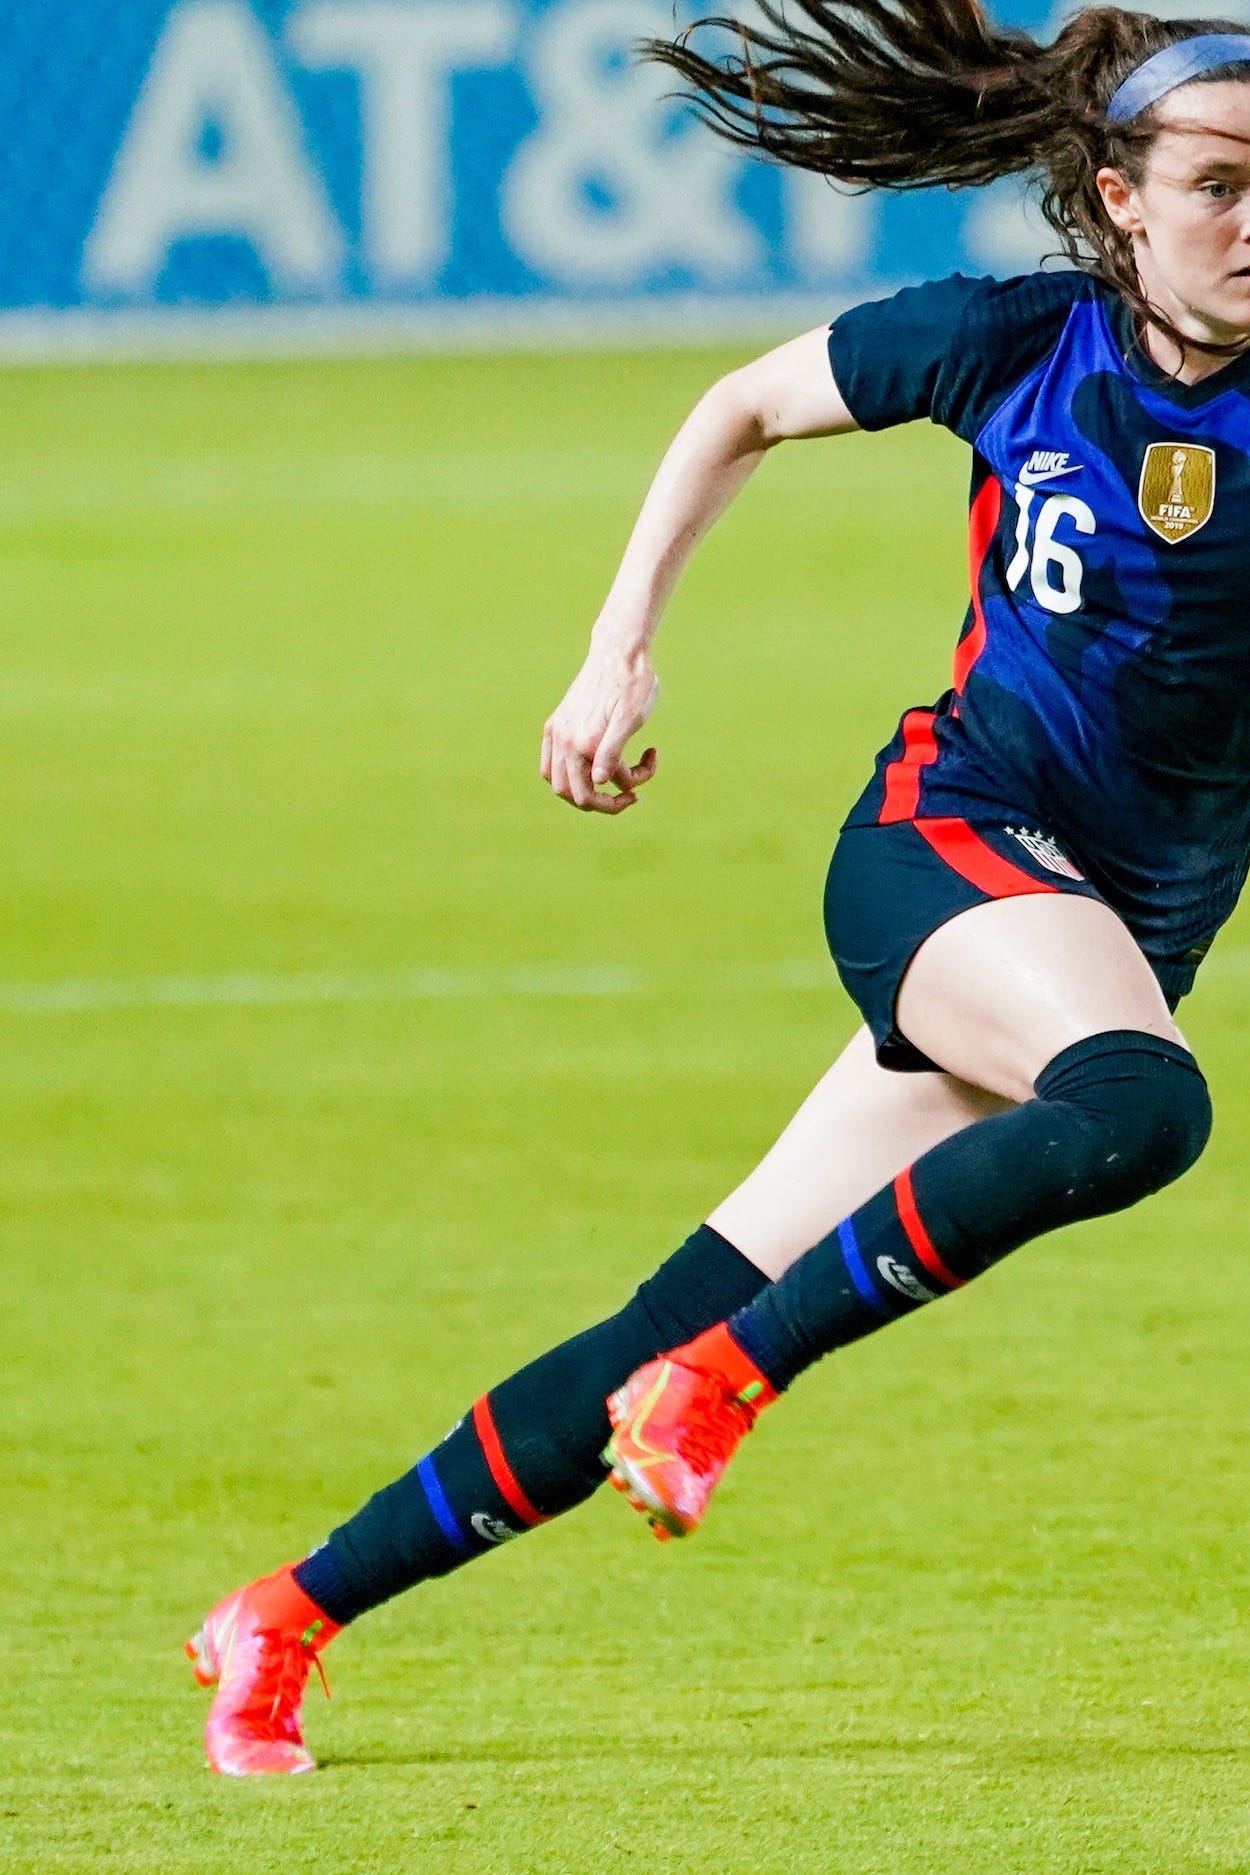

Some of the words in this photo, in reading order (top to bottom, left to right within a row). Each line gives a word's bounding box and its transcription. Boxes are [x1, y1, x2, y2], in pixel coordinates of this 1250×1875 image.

[1028, 450, 1070, 472] NIKE
[1158, 504, 1192, 519] FIFA
[1006, 482, 1096, 614] 16
